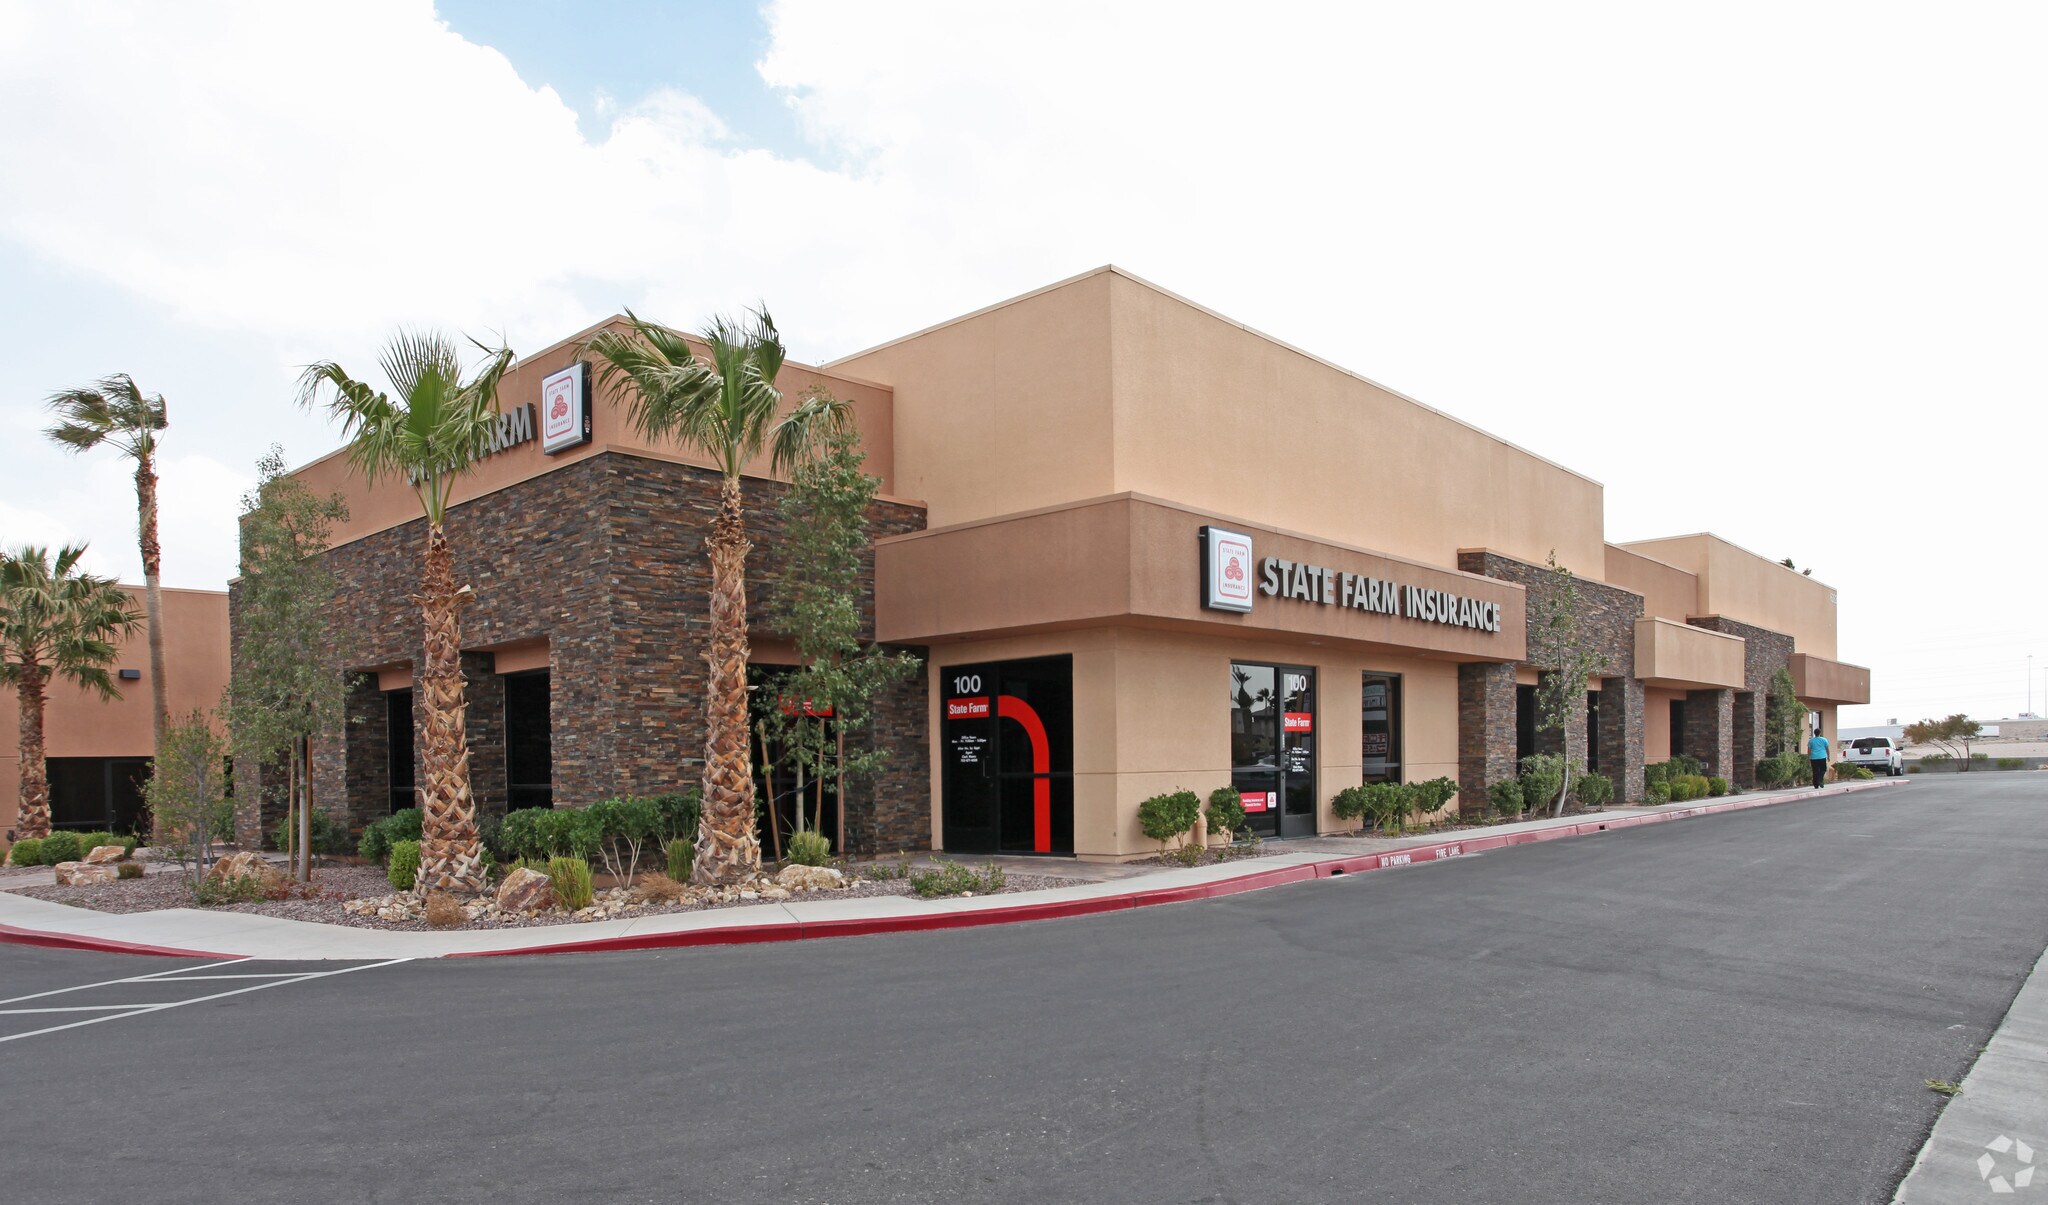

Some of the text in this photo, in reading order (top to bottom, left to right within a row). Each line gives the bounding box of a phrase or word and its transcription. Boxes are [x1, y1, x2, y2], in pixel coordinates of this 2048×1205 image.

[1222, 582, 1246, 591] INSURANCE
[1259, 556, 1500, 632] STATE FARM INSURANCE
[953, 674, 981, 694] 100
[1288, 675, 1307, 692] 100
[950, 704, 967, 714] State
[1284, 717, 1310, 727] State Farm
[1436, 846, 1460, 858] FIRE LANE
[1381, 855, 1411, 867] NO PARKING
